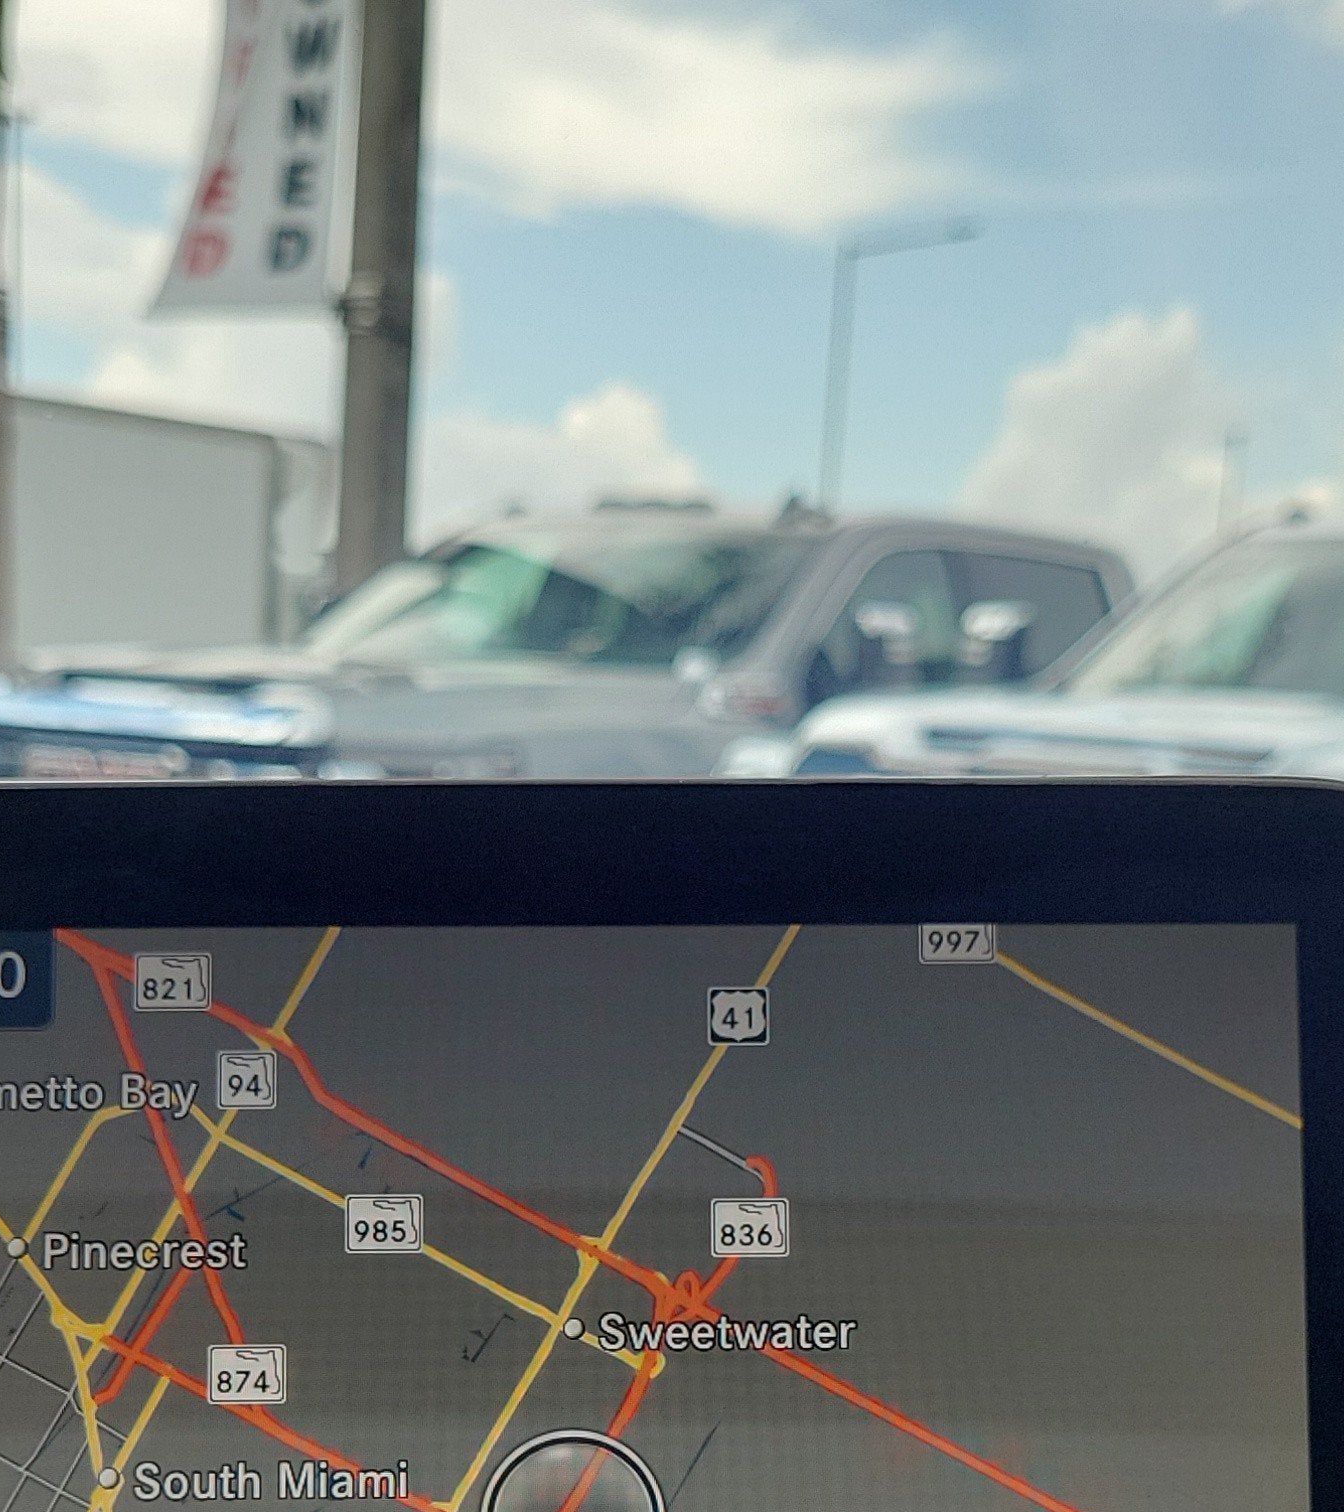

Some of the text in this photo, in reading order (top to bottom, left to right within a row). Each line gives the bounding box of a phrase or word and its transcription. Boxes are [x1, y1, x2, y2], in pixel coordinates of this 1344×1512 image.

[269, 0, 340, 274] WNED
[928, 931, 982, 954] 997
[143, 978, 197, 1001] 821
[720, 1007, 756, 1030] 41
[120, 1078, 197, 1117] Bay
[227, 1074, 263, 1098] 94
[354, 1221, 407, 1243] 985
[720, 1224, 773, 1247] 836
[42, 1235, 246, 1269] Pinecrest
[598, 1315, 857, 1351] Sweetwater
[216, 1371, 269, 1393] 874
[133, 1461, 408, 1500] South Miami
